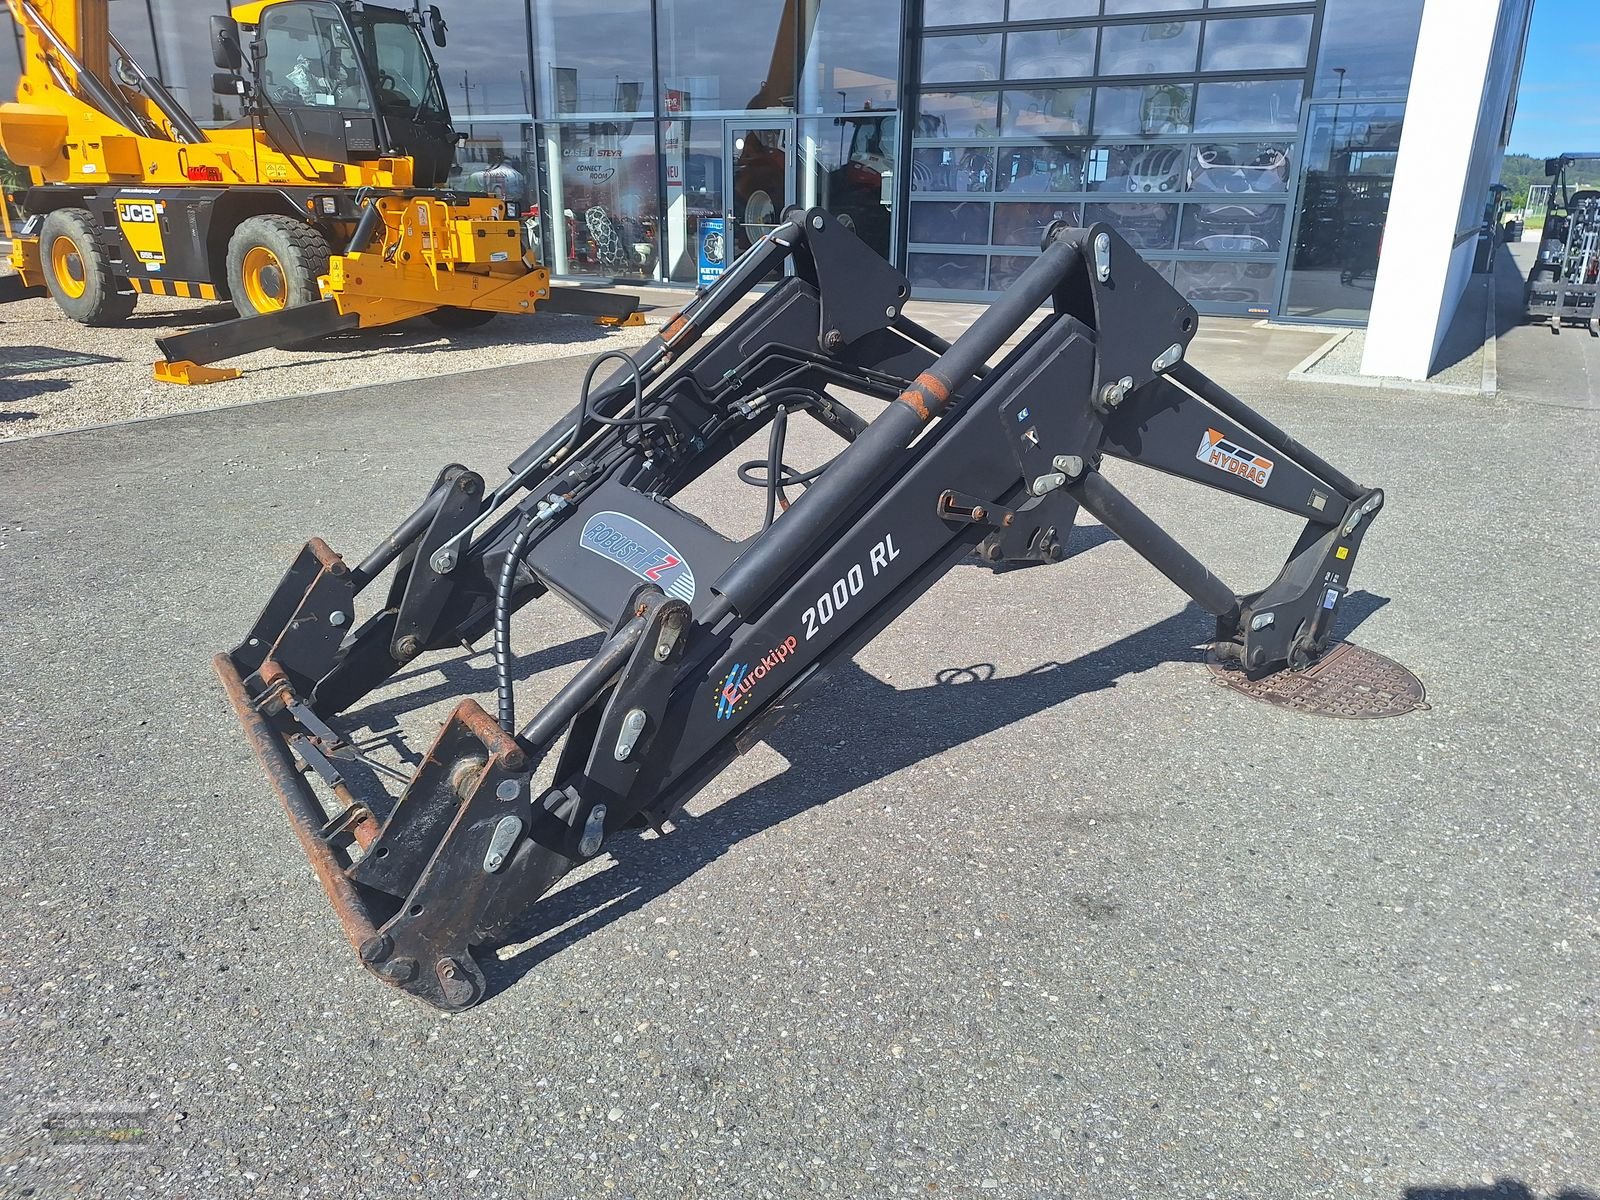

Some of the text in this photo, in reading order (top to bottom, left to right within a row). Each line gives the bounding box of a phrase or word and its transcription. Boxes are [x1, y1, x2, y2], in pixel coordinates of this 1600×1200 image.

[563, 149, 587, 157] CASE
[119, 204, 155, 222] JCB
[1209, 449, 1266, 485] HYDRAC
[584, 522, 682, 582] ROBUST FZ
[722, 533, 901, 706] Eurokipp 2000 RL
